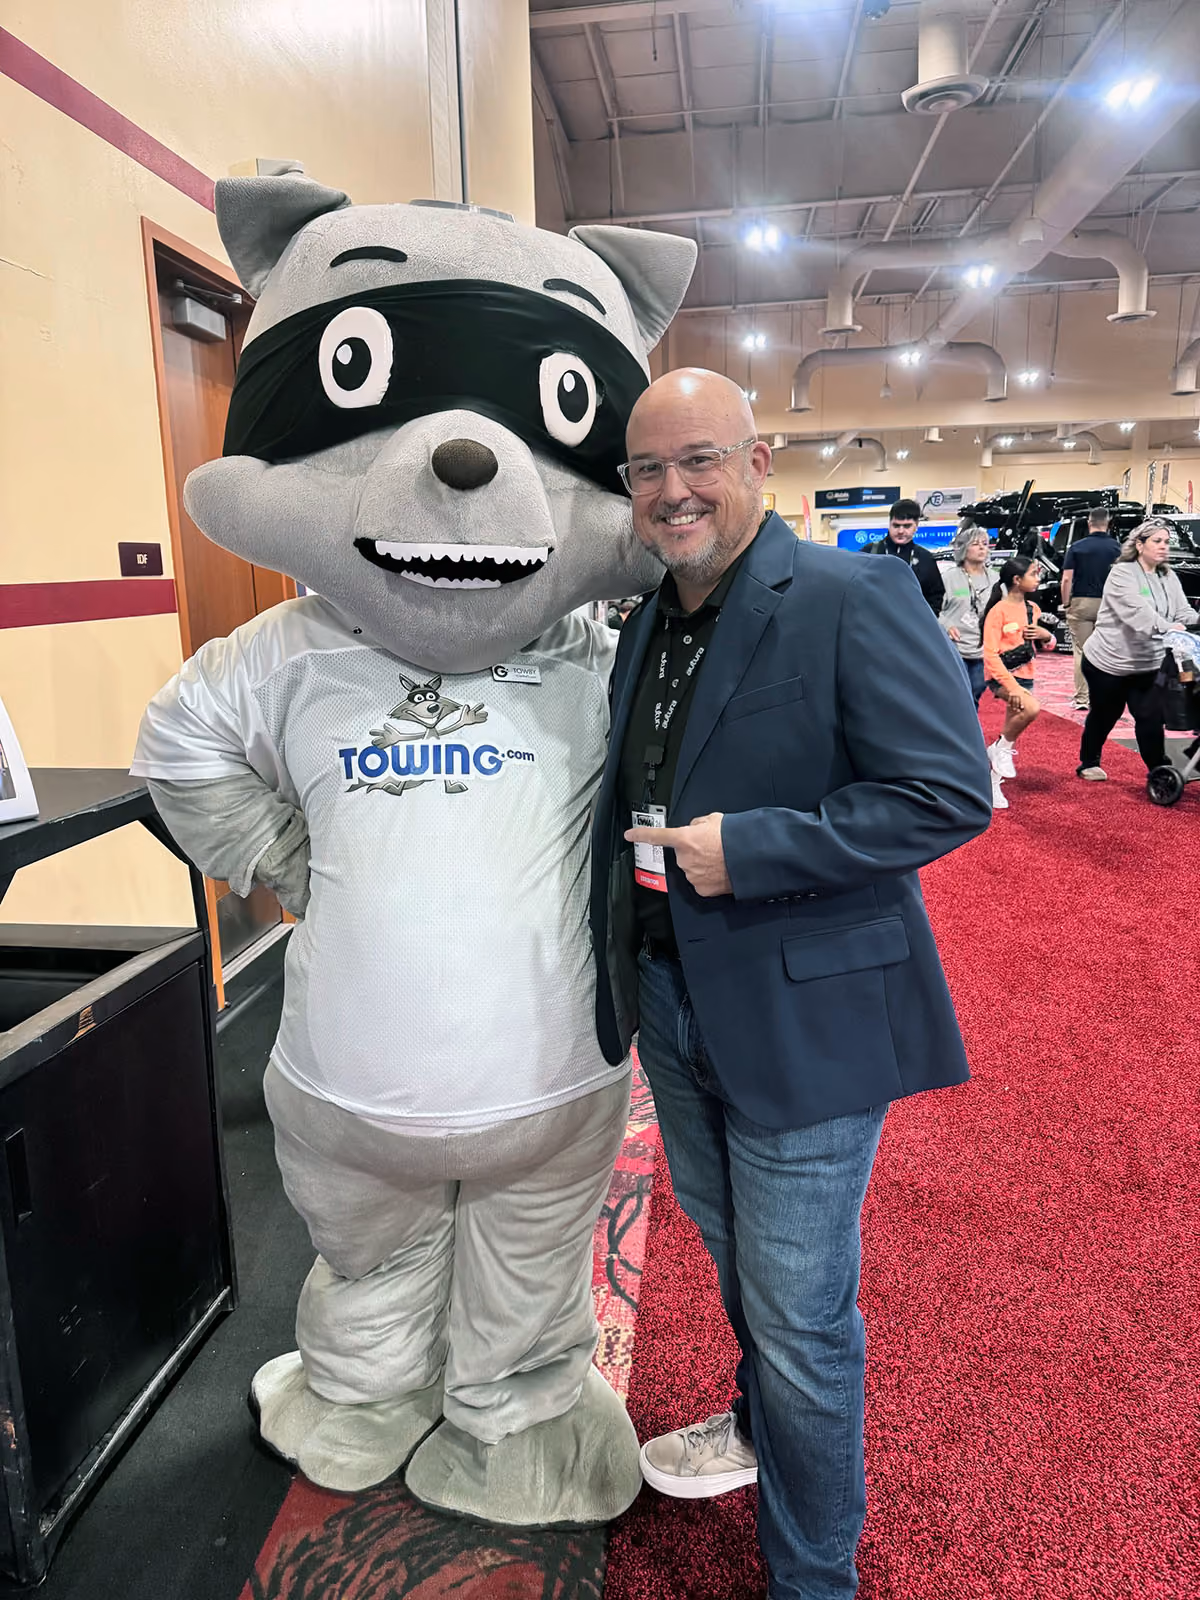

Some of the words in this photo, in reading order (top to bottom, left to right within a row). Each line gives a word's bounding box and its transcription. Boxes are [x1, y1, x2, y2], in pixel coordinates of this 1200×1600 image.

[136, 553, 148, 565] IDF
[686, 647, 704, 676] autura
[661, 700, 678, 729] autura
